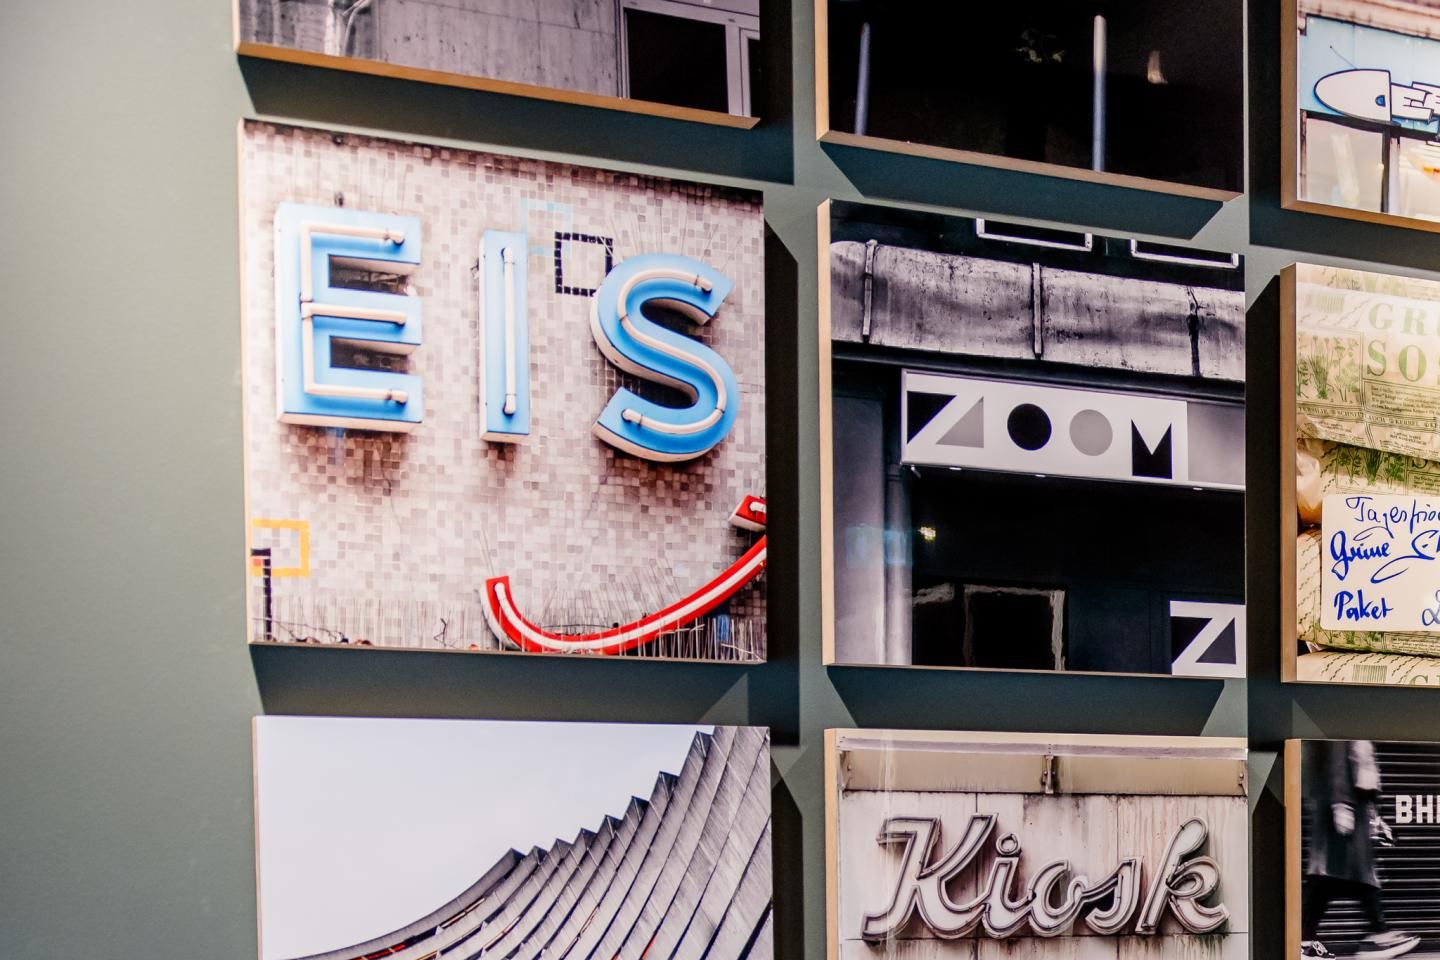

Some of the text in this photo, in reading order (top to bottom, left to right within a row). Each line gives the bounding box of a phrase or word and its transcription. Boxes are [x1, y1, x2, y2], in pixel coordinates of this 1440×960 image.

[274, 202, 741, 463] EIS
[904, 389, 1174, 480] ZOOM
[1333, 588, 1394, 623] Paket
[861, 812, 1230, 941] Kiosk
